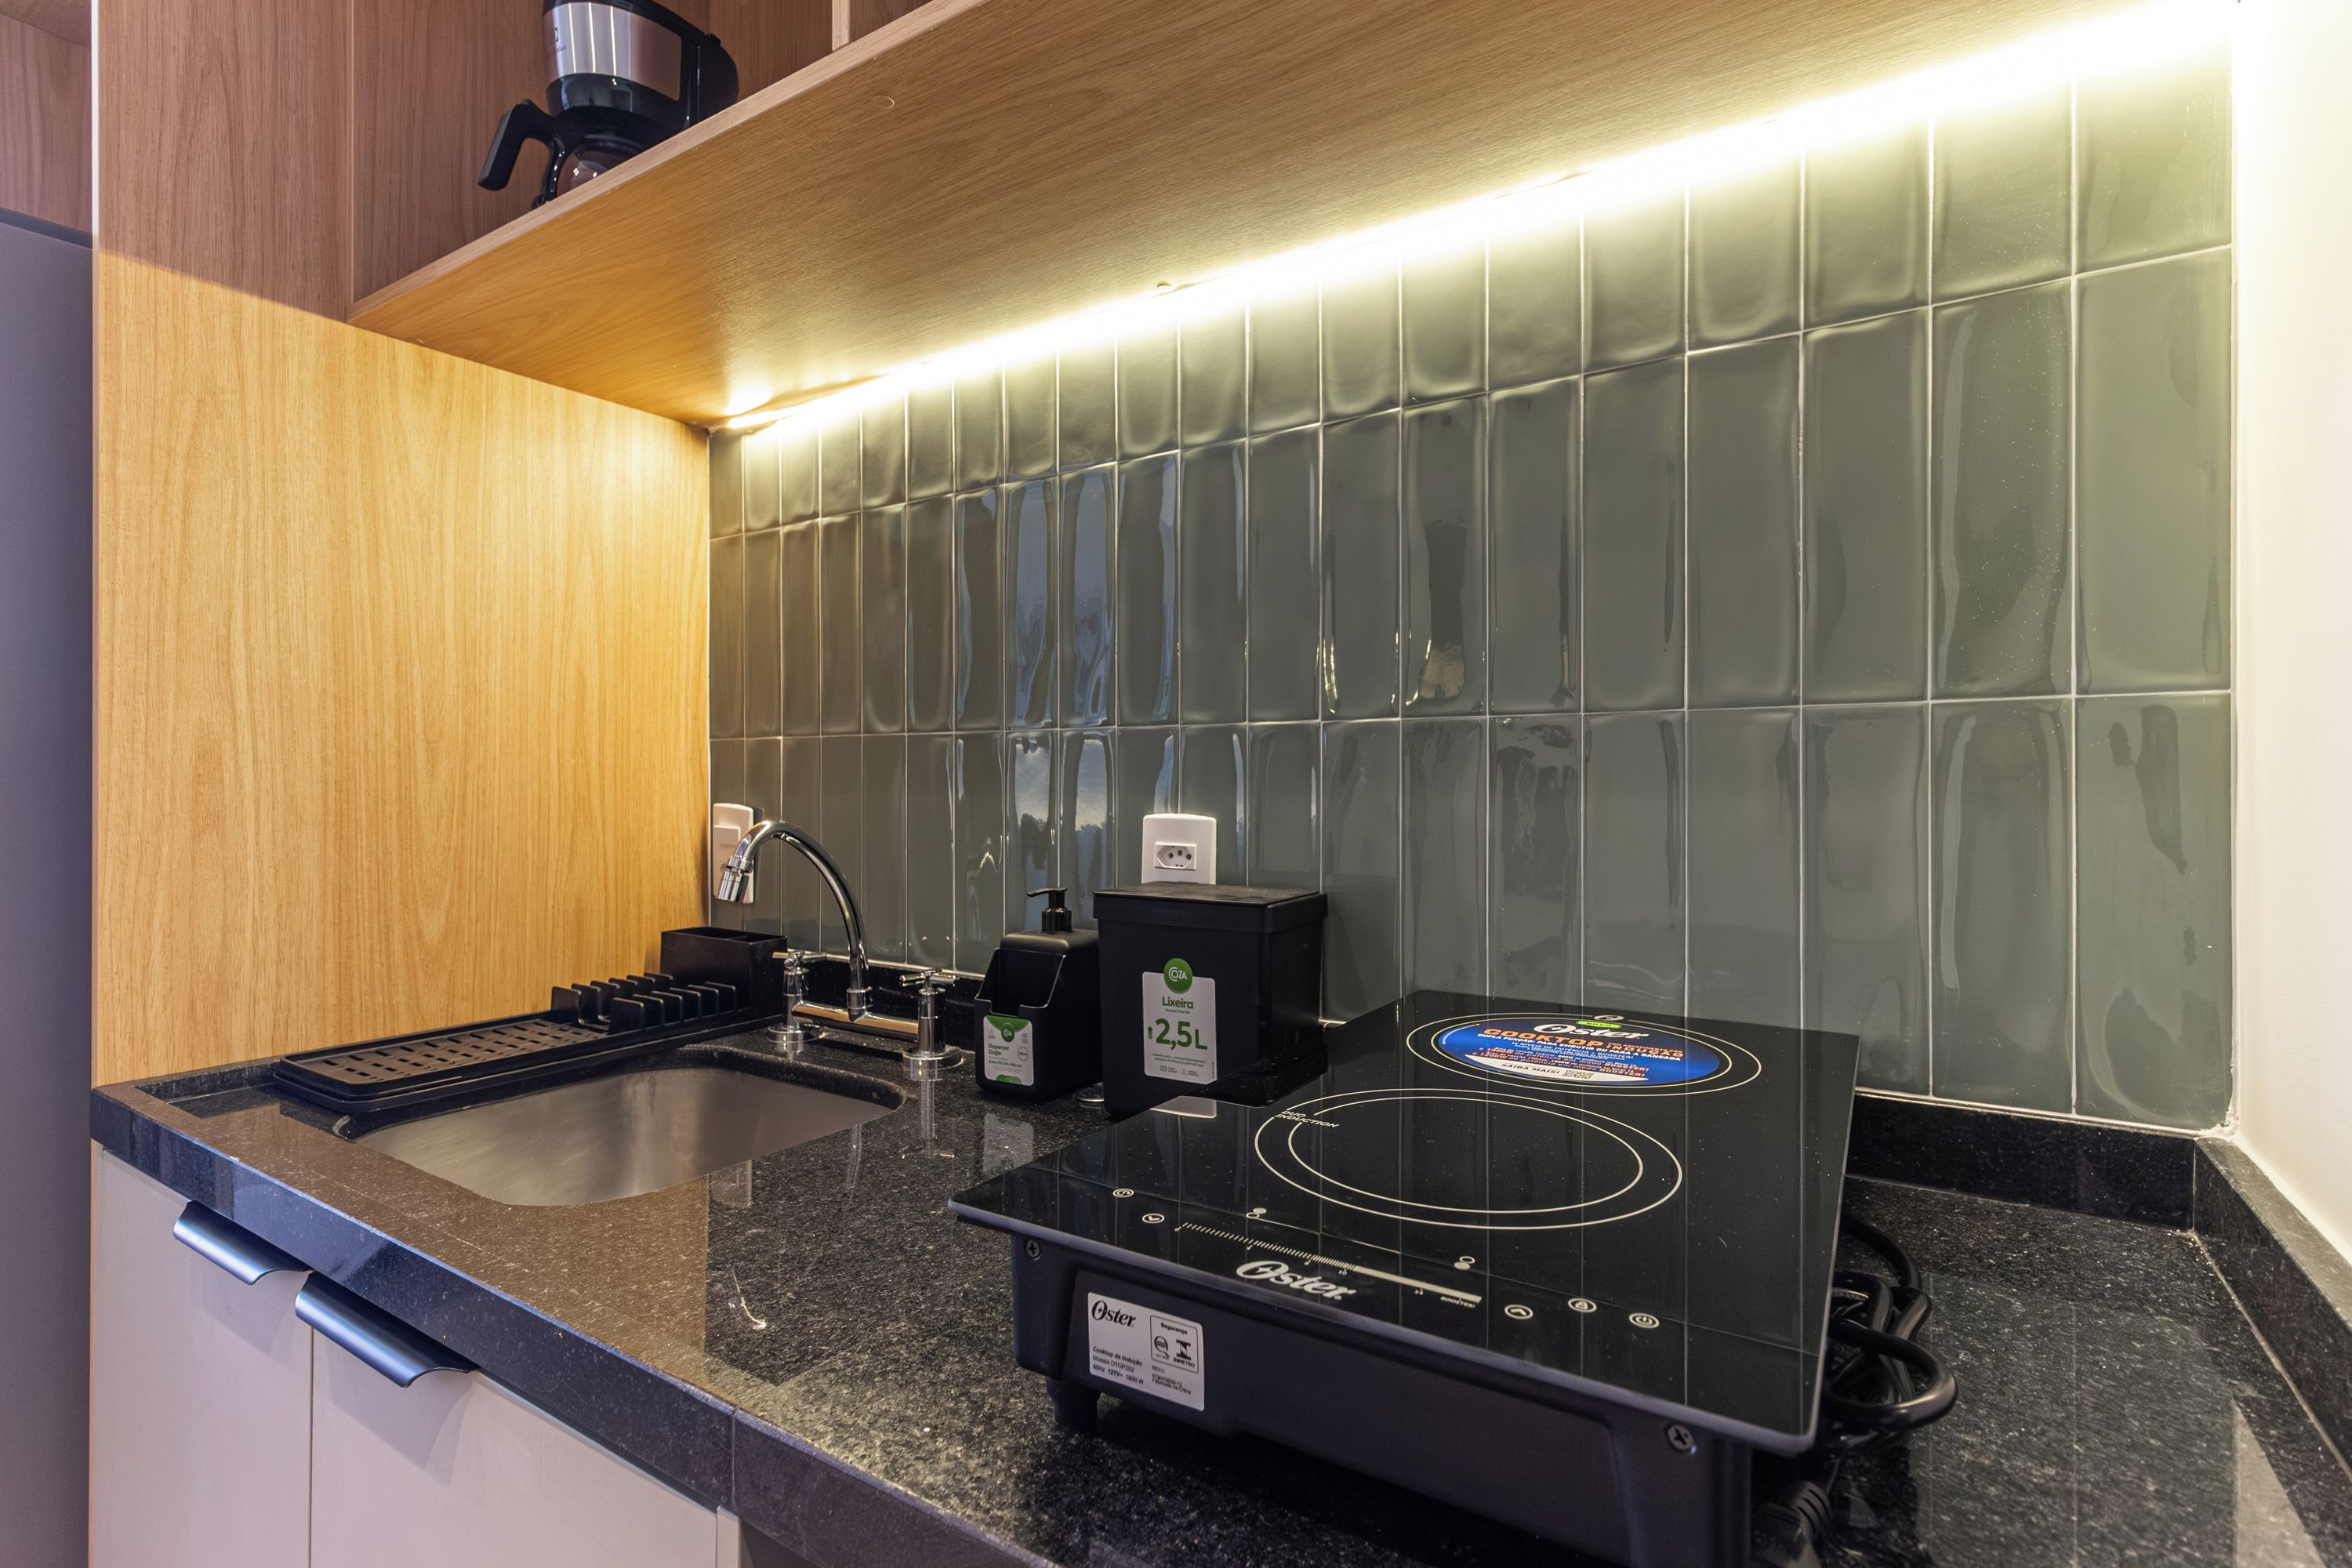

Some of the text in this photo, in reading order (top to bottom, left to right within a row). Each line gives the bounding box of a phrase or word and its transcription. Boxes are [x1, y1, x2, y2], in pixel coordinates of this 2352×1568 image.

[1168, 967, 1188, 982] COZA
[1162, 996, 1193, 1009] Lixeira
[1483, 1029, 1604, 1047] COOKTOP
[1534, 1024, 1650, 1039] Oster
[1606, 1044, 1684, 1058] INDUÇÃO
[1641, 1053, 1681, 1062] BANCADA
[1275, 1114, 1341, 1127] INDUCTION
[1236, 1261, 1357, 1297] Oster
[1091, 1301, 1136, 1327] Oster
[1161, 1322, 1188, 1334] Segurança
[1093, 1346, 1113, 1358] Cooktop
[1122, 1355, 1142, 1367] Indução
[1093, 1355, 1110, 1365] Modelo
[1173, 1357, 1196, 1368] INMETRO
